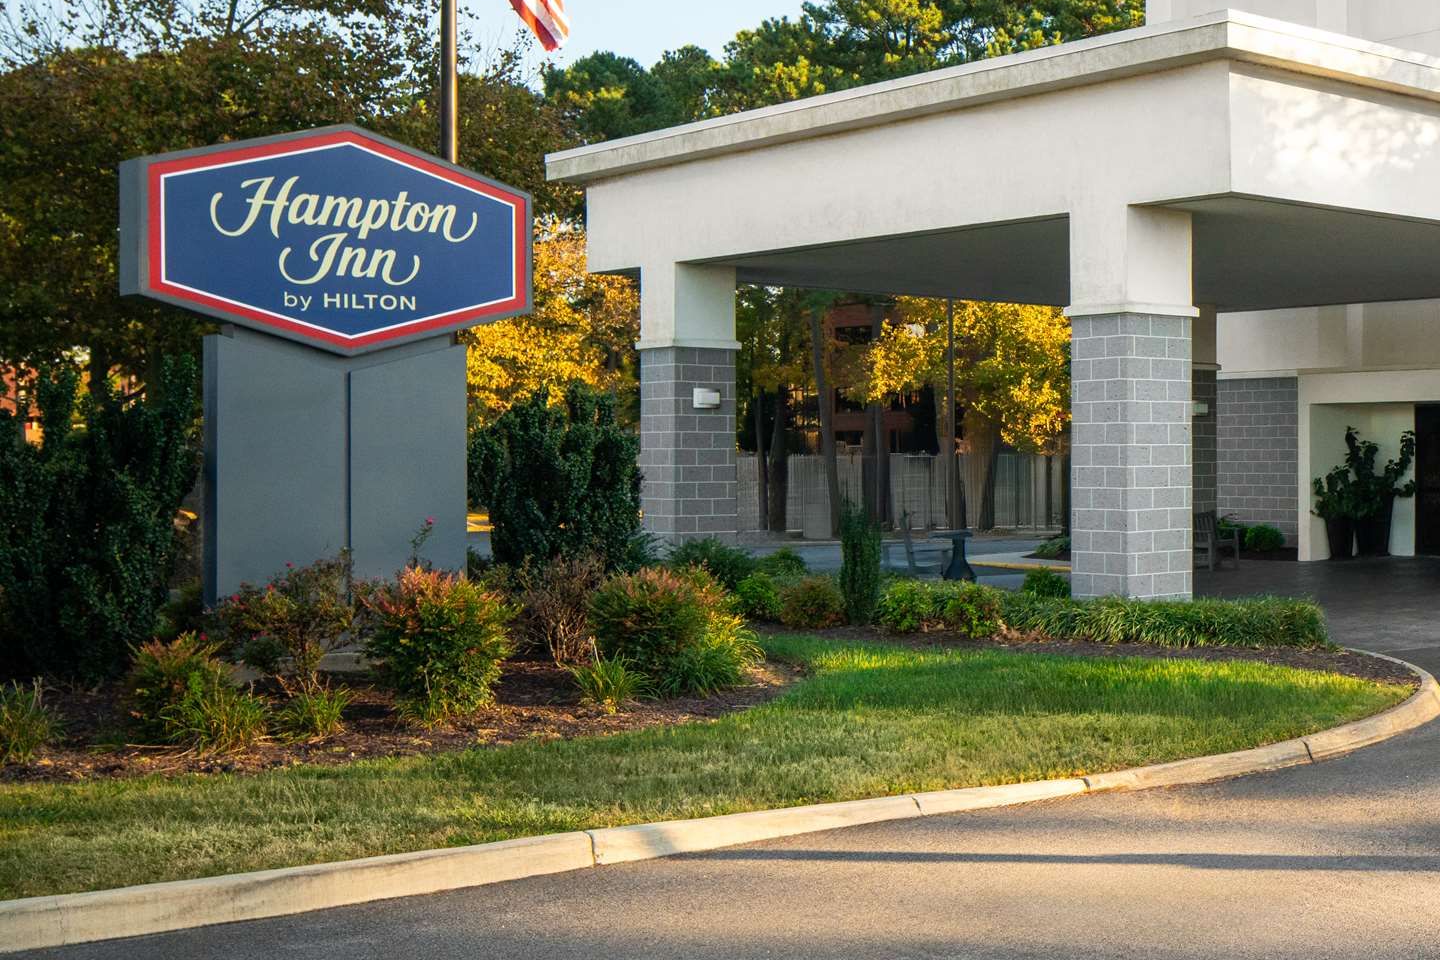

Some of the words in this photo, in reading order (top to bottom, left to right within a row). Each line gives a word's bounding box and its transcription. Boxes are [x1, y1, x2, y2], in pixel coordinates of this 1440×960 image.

[210, 176, 478, 242] Hampton
[279, 233, 420, 285] Inn
[284, 292, 312, 311] by
[323, 292, 416, 311] HILTON
